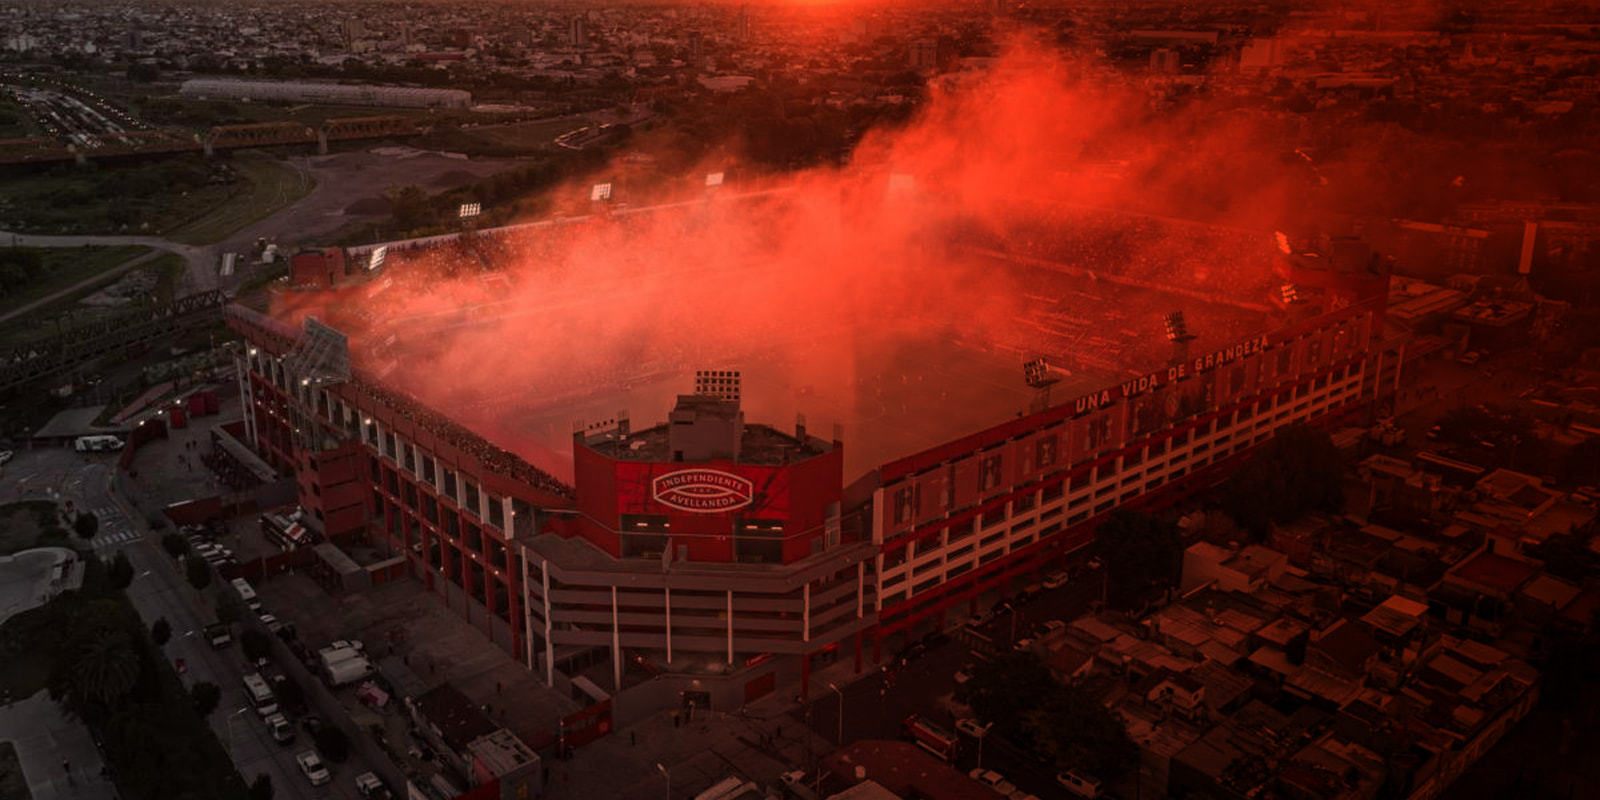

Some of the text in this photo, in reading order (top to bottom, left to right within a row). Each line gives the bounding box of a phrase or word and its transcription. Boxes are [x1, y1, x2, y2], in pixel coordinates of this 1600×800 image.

[1076, 334, 1268, 413] UNA VIDA DE GRANDEZA
[662, 475, 743, 489] INDEPENDIENTE
[670, 495, 735, 507] AVELLANEDA
